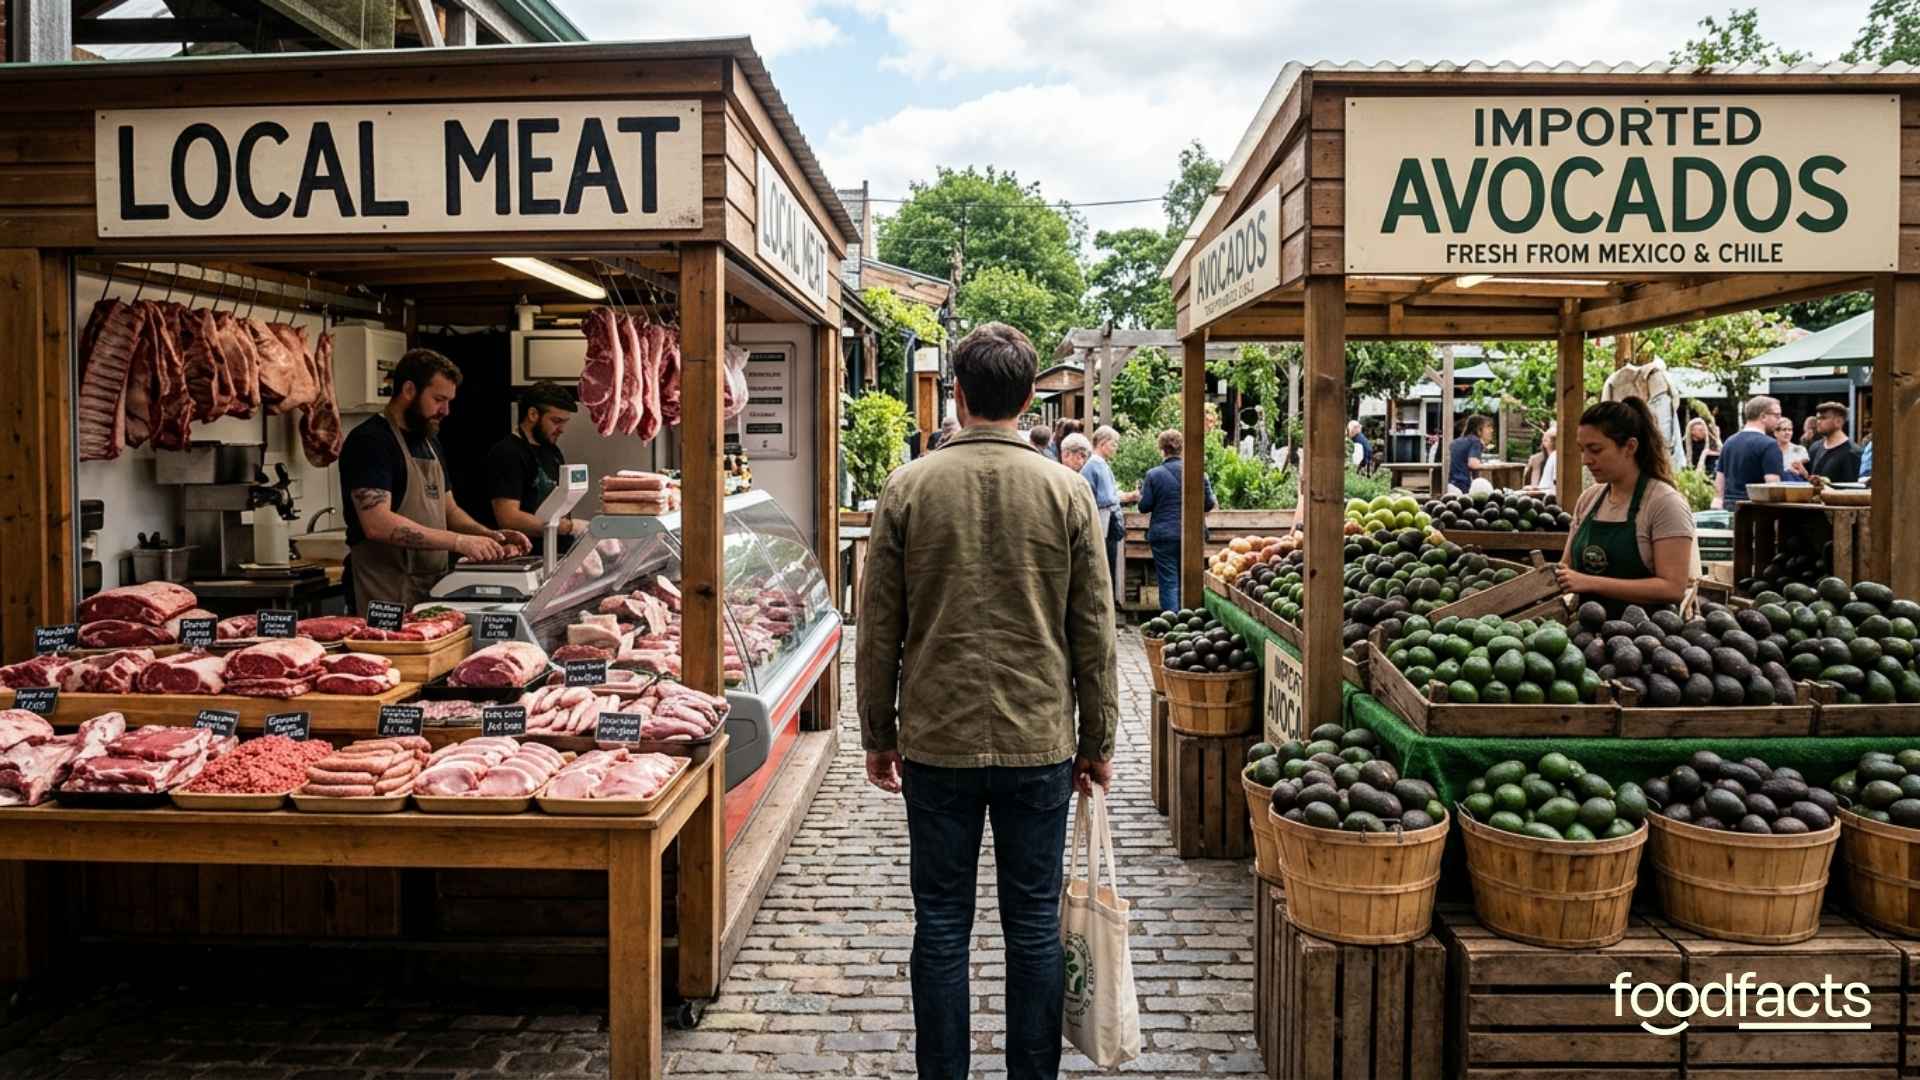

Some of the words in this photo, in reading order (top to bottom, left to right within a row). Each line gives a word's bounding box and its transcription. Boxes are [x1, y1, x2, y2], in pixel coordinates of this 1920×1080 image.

[1474, 106, 1762, 147] IMPORTED
[118, 121, 410, 221] LOCAL
[444, 115, 681, 217] MEAT
[1380, 154, 1849, 234] AVOCADOS
[1197, 209, 1268, 304] AVOCADOS
[1446, 243, 1517, 264] FRESH
[1526, 243, 1590, 264] FROM
[1598, 243, 1686, 264] MEXICO
[1693, 242, 1710, 264] &
[1718, 242, 1783, 264] CHILE
